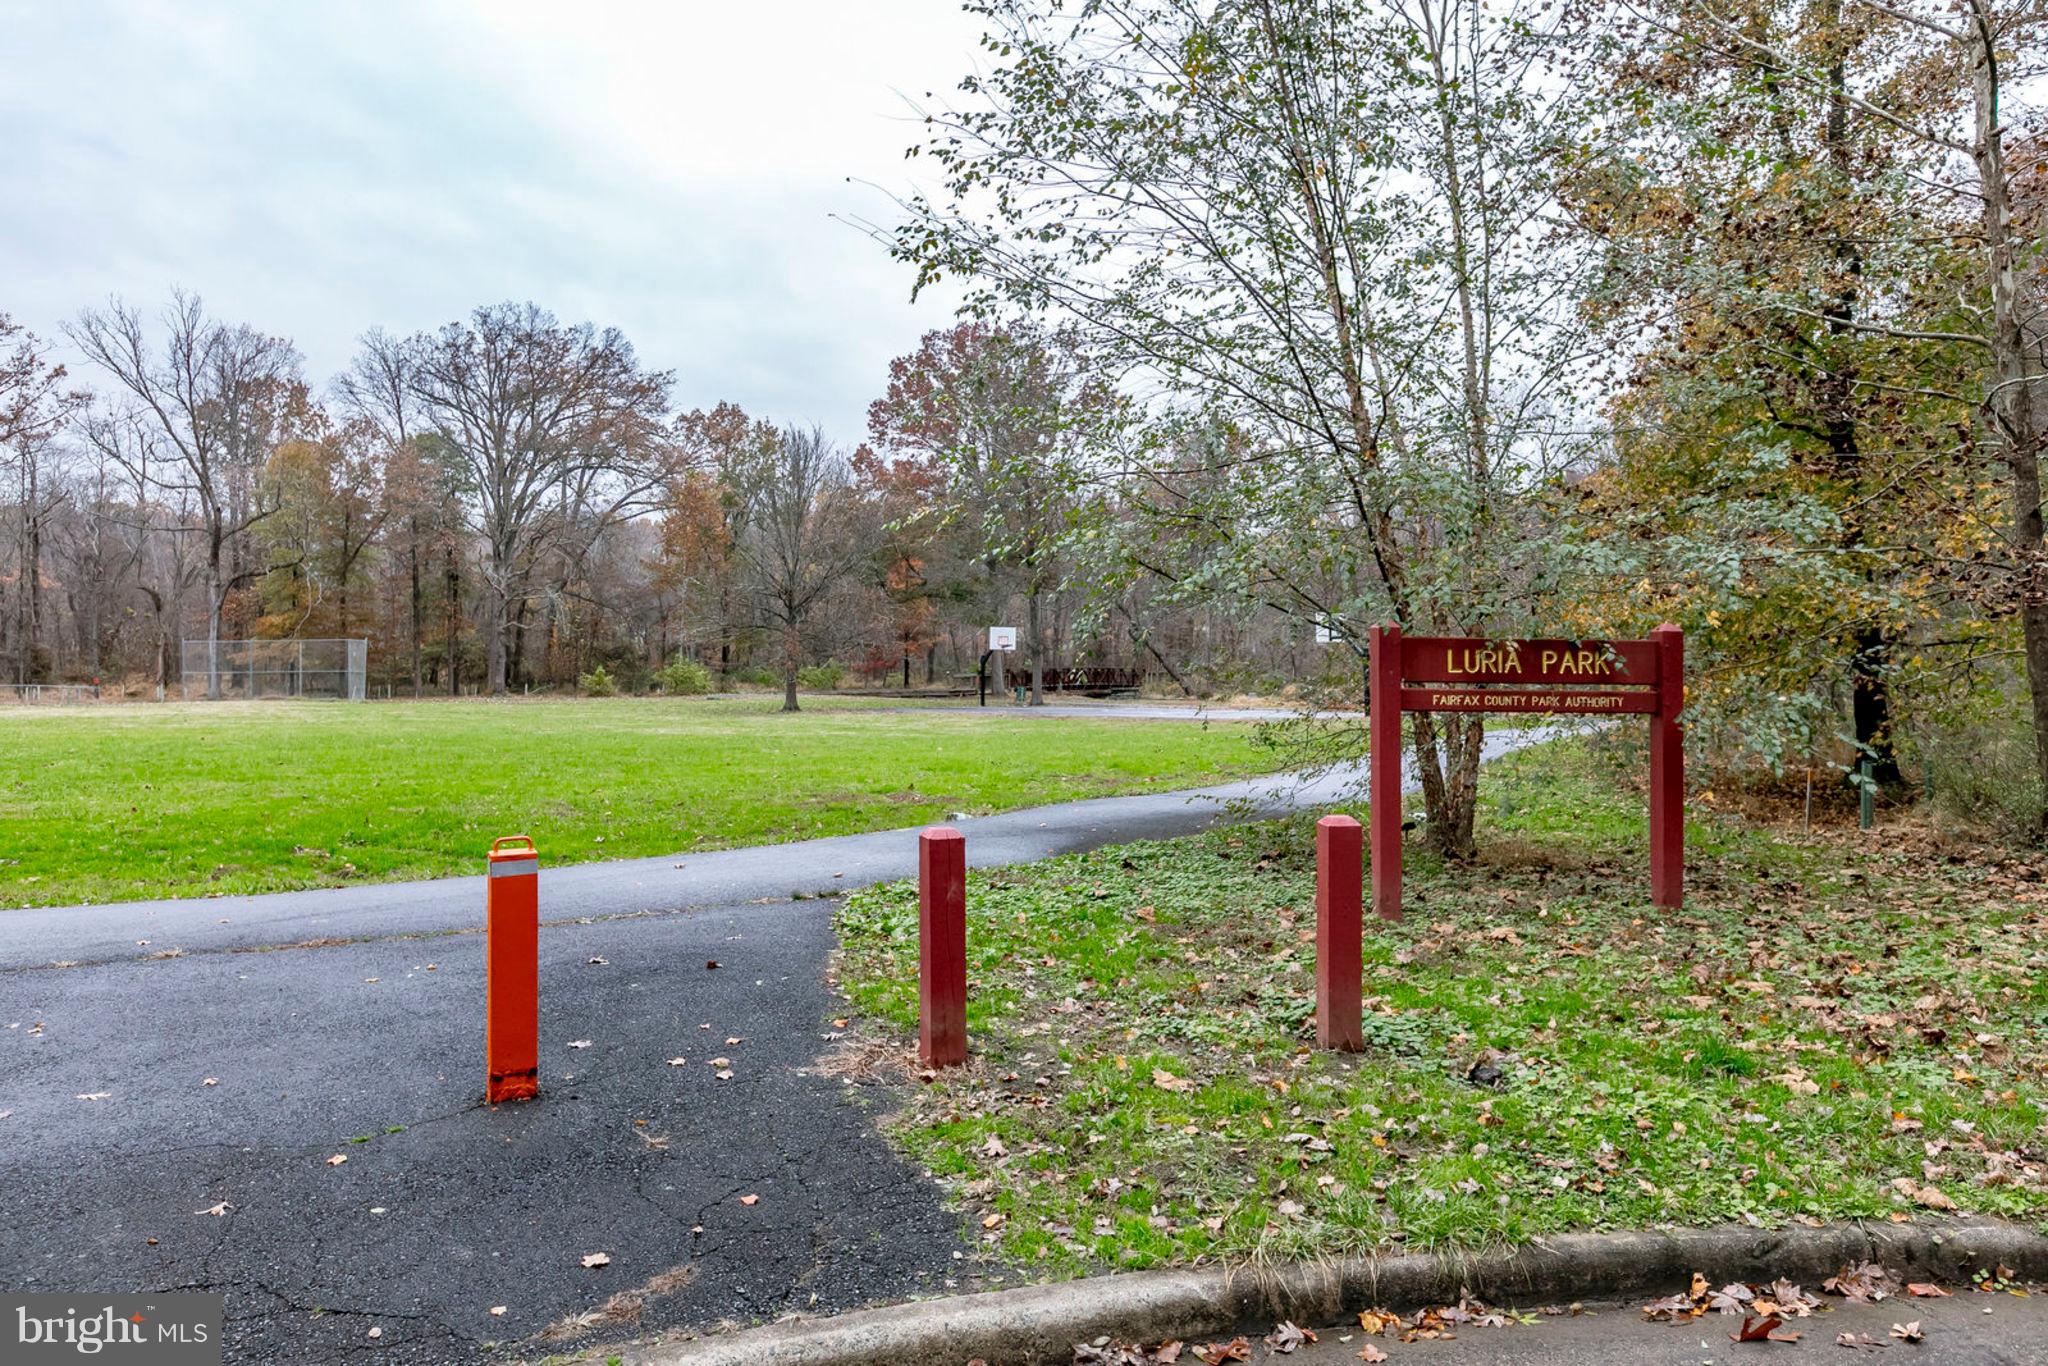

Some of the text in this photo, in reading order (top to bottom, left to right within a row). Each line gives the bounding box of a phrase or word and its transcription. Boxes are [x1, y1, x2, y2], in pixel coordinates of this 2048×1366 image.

[1447, 649, 1611, 675] LURIA PARK
[1432, 694, 1624, 708] FAIRFAX COUNTY PARK AUTHORITY
